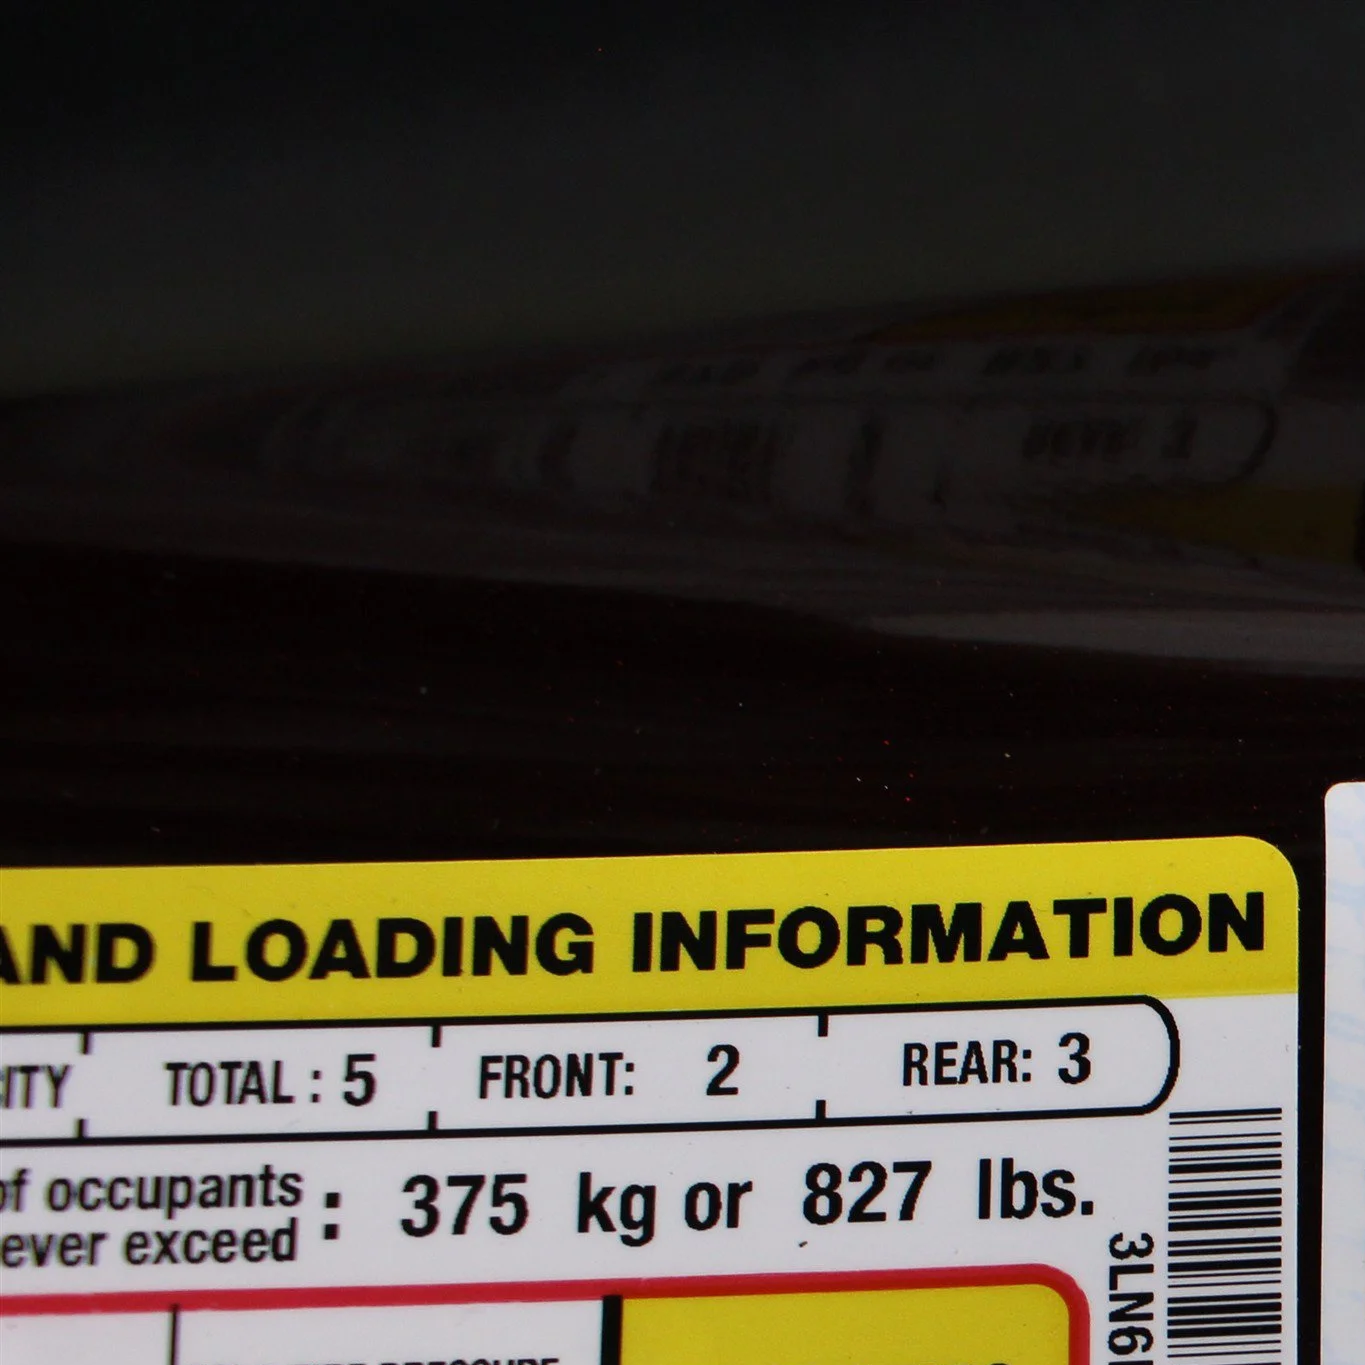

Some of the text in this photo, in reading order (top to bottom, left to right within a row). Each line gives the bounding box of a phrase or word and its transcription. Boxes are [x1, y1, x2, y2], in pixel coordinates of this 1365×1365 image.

[189, 891, 1264, 982] LOADING INFORMATION
[479, 1044, 739, 1099] FRONT: 2
[903, 1032, 1091, 1086] REAR: 3
[45, 1164, 302, 1220] occupants
[400, 1158, 1093, 1247] 375 kg or 827 lbs.
[123, 1217, 297, 1265] exceed
